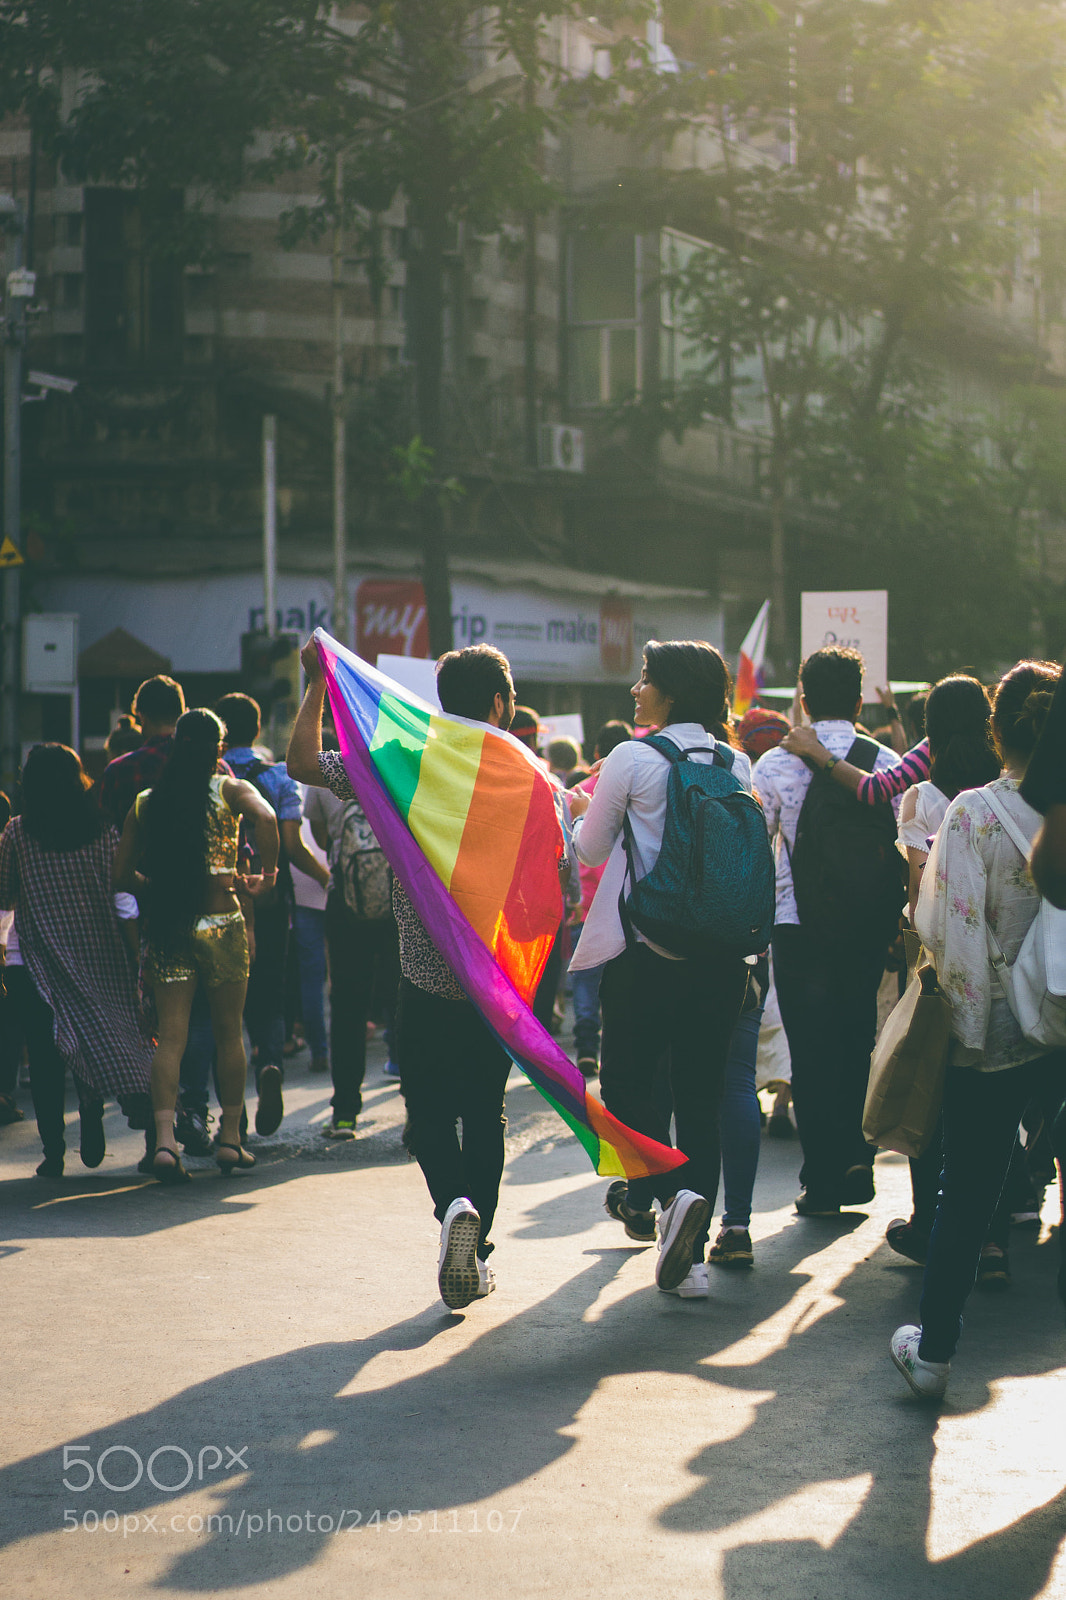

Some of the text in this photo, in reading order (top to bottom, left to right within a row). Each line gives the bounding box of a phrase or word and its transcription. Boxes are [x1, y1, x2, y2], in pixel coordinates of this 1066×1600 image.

[248, 600, 337, 632] mak
[363, 604, 426, 657] my
[546, 613, 599, 644] make
